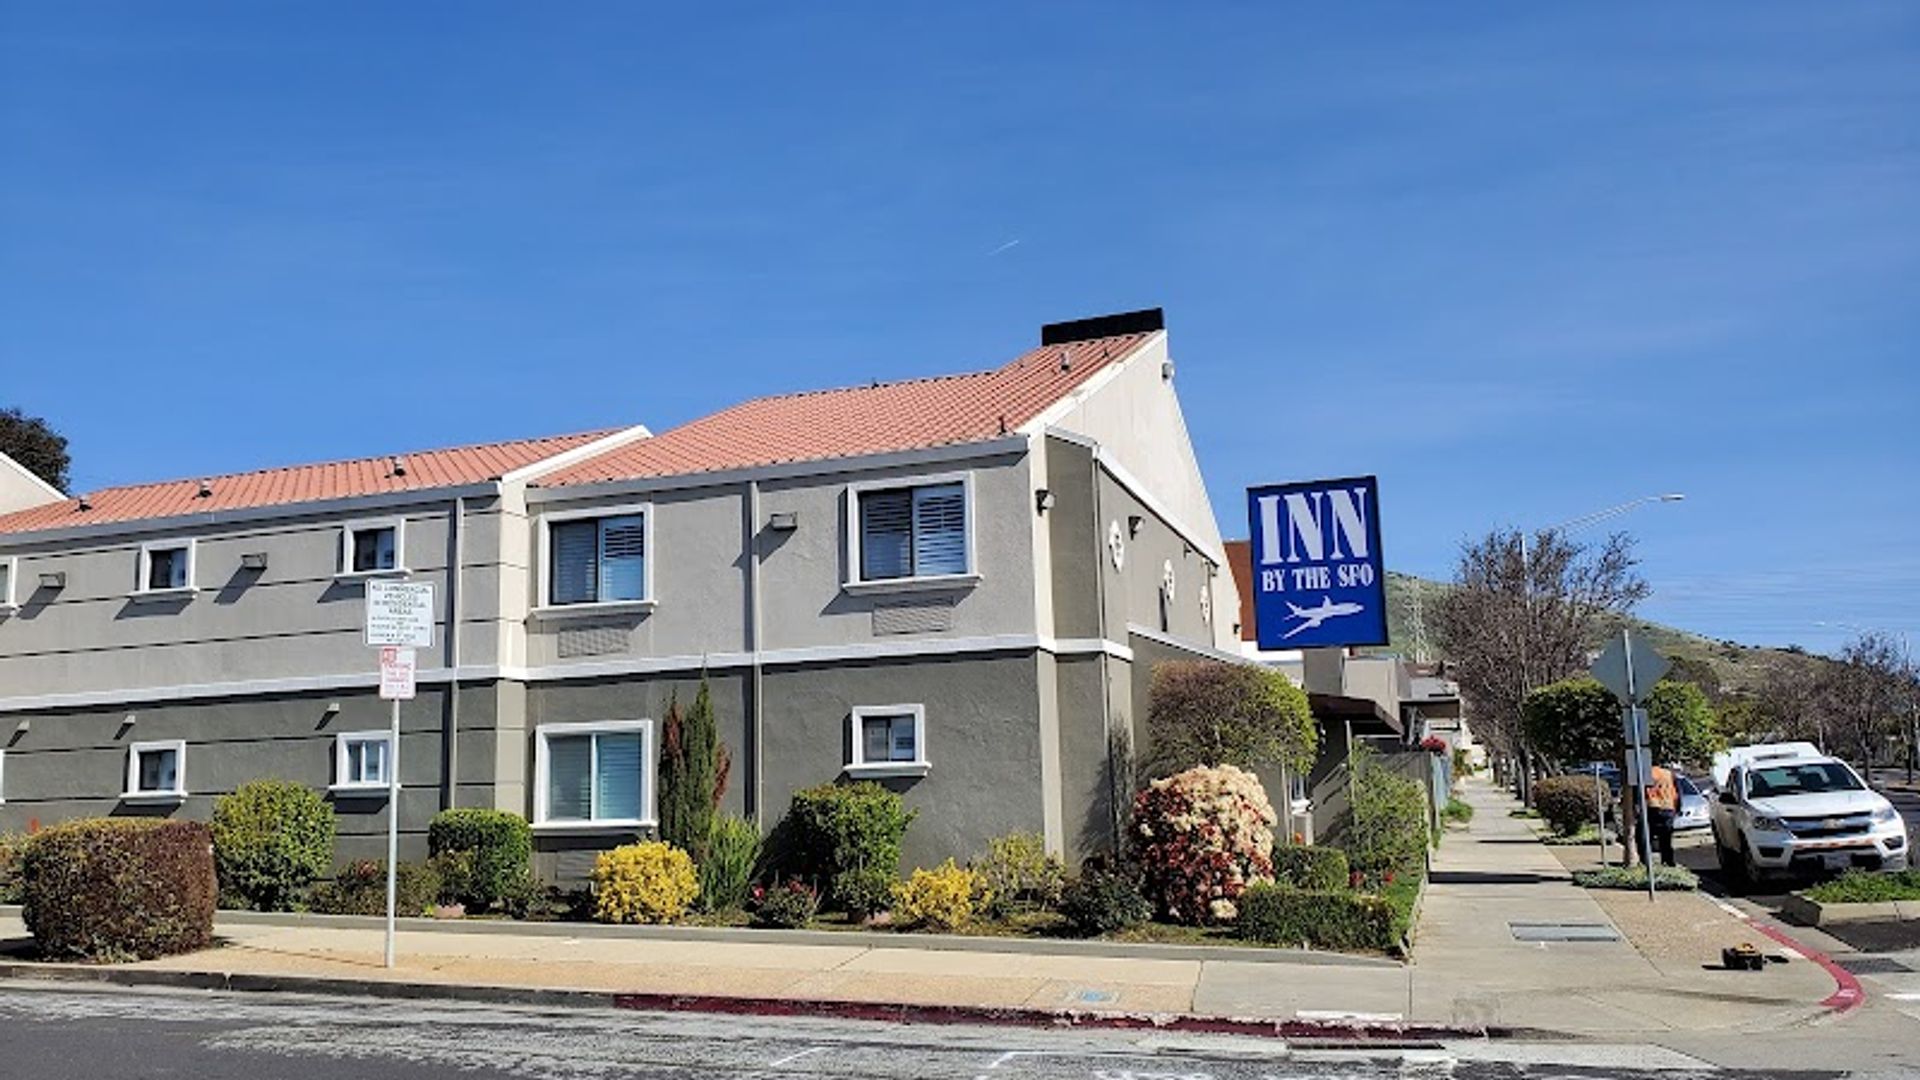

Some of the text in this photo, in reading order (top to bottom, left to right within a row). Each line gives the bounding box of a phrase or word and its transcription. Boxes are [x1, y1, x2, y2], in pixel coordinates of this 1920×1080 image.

[1258, 487, 1368, 565] INN
[1261, 563, 1374, 592] BY THE SFO
